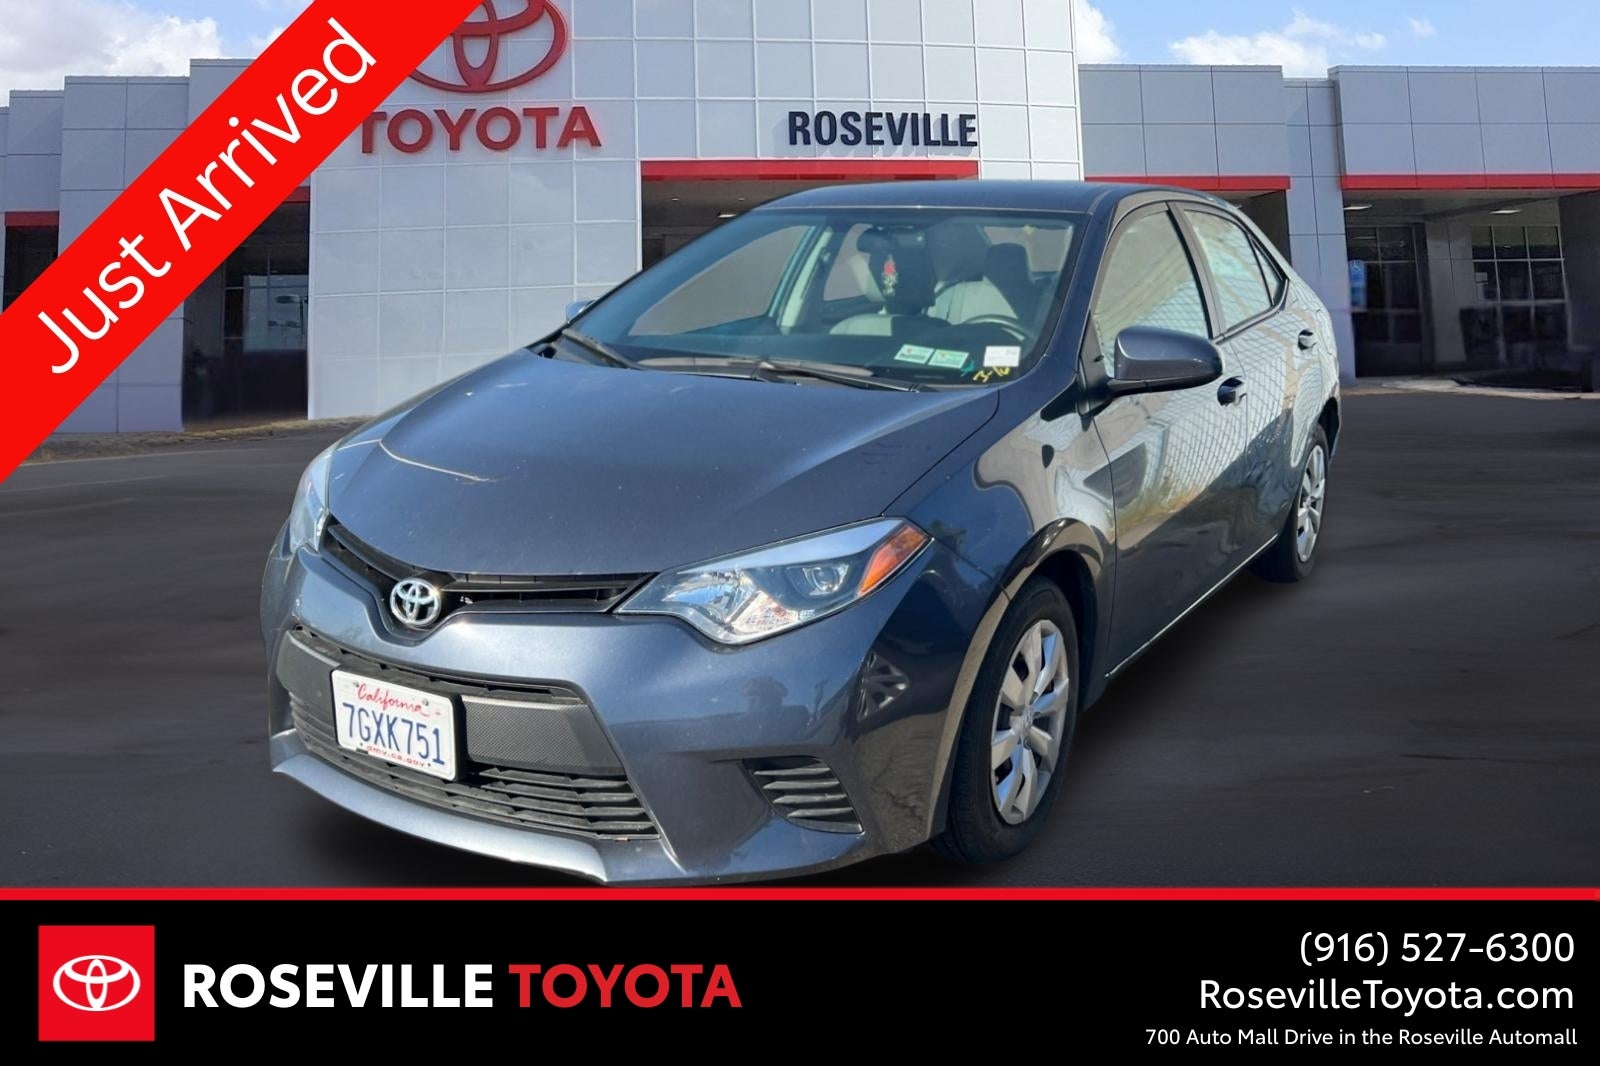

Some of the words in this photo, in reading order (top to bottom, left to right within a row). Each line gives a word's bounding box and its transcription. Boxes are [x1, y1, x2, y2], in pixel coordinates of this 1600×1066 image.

[360, 106, 602, 154] TOYOTA
[788, 110, 978, 147] ROSEVILLE
[357, 683, 430, 717] California
[342, 702, 445, 765] 7GXK751
